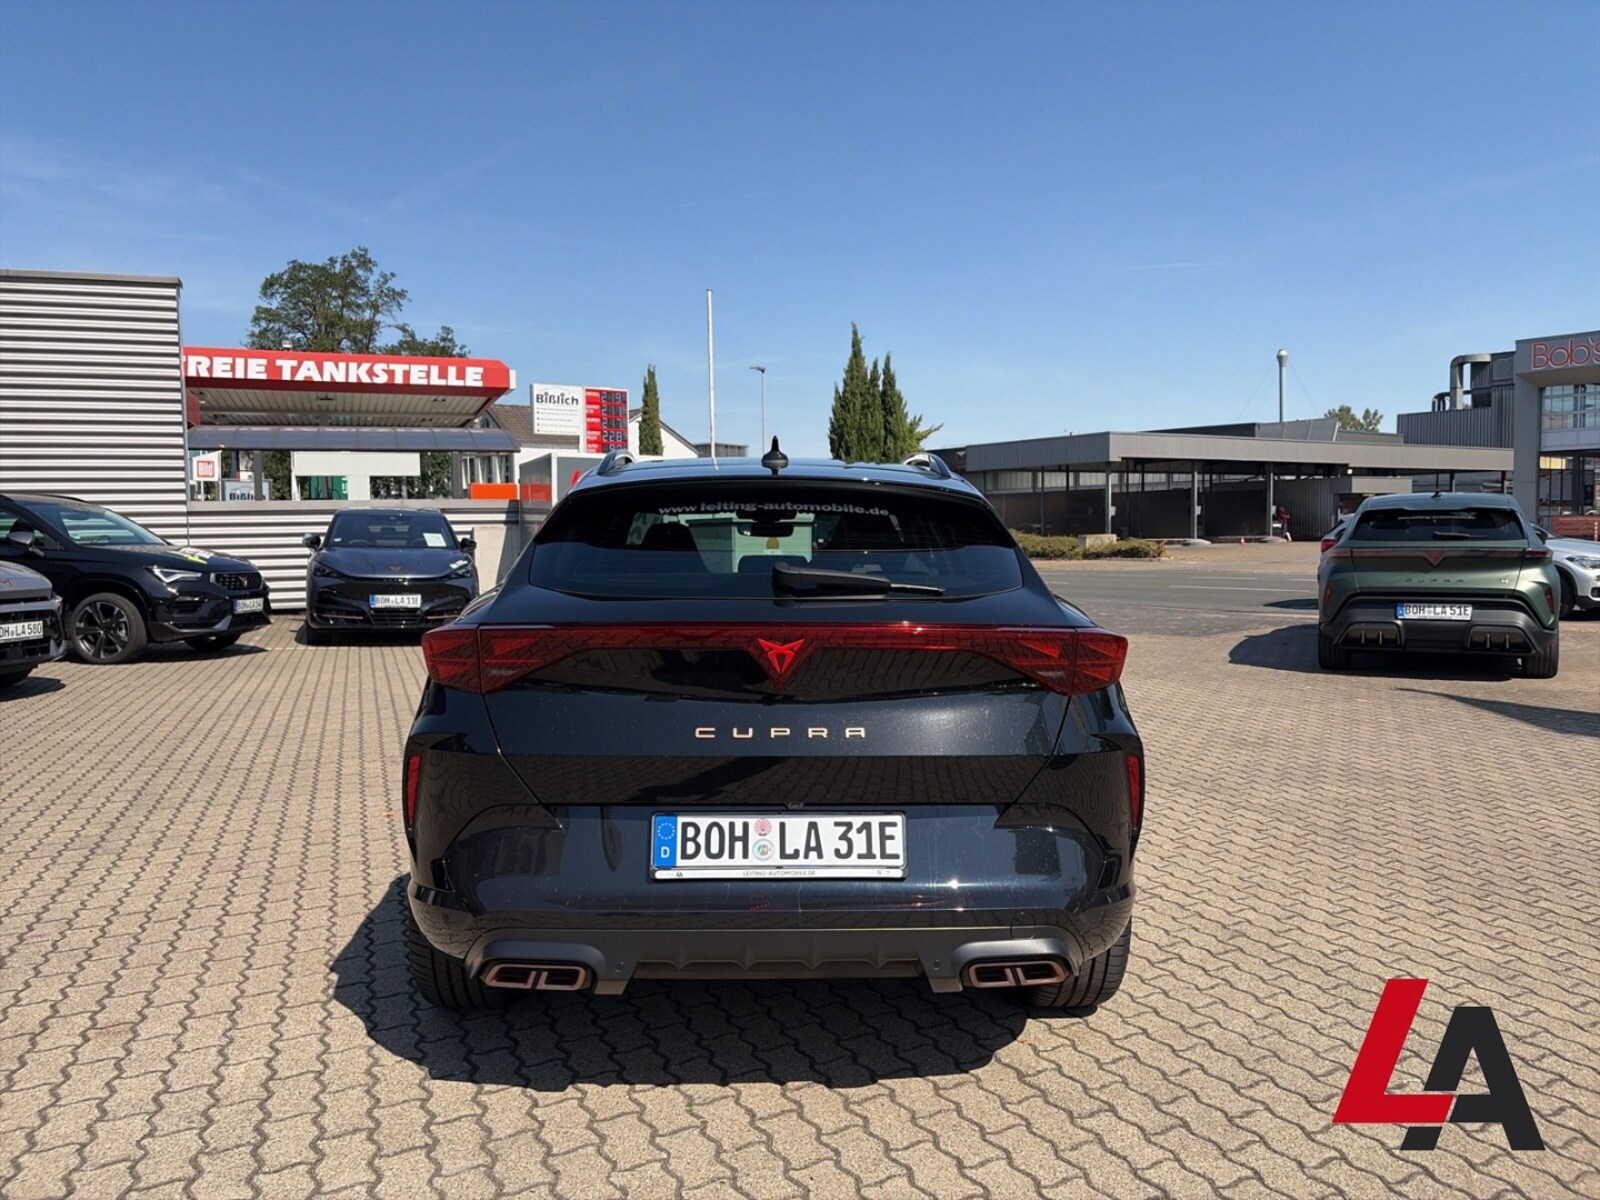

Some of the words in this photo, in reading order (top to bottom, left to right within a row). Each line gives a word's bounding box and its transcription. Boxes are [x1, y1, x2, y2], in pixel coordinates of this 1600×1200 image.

[183, 355, 267, 380] REIE
[275, 359, 484, 387] TANKSTELLE
[536, 391, 579, 405] Bißlich
[1405, 604, 1426, 615] BOH
[1433, 605, 1447, 616] LA
[1450, 605, 1470, 616] 51E
[16, 624, 26, 636] LA
[27, 622, 42, 635] 580
[695, 727, 866, 738] CUPRA
[680, 821, 749, 860] BOH
[779, 821, 824, 860] LA
[833, 821, 900, 860] 31E
[661, 846, 670, 858] D
